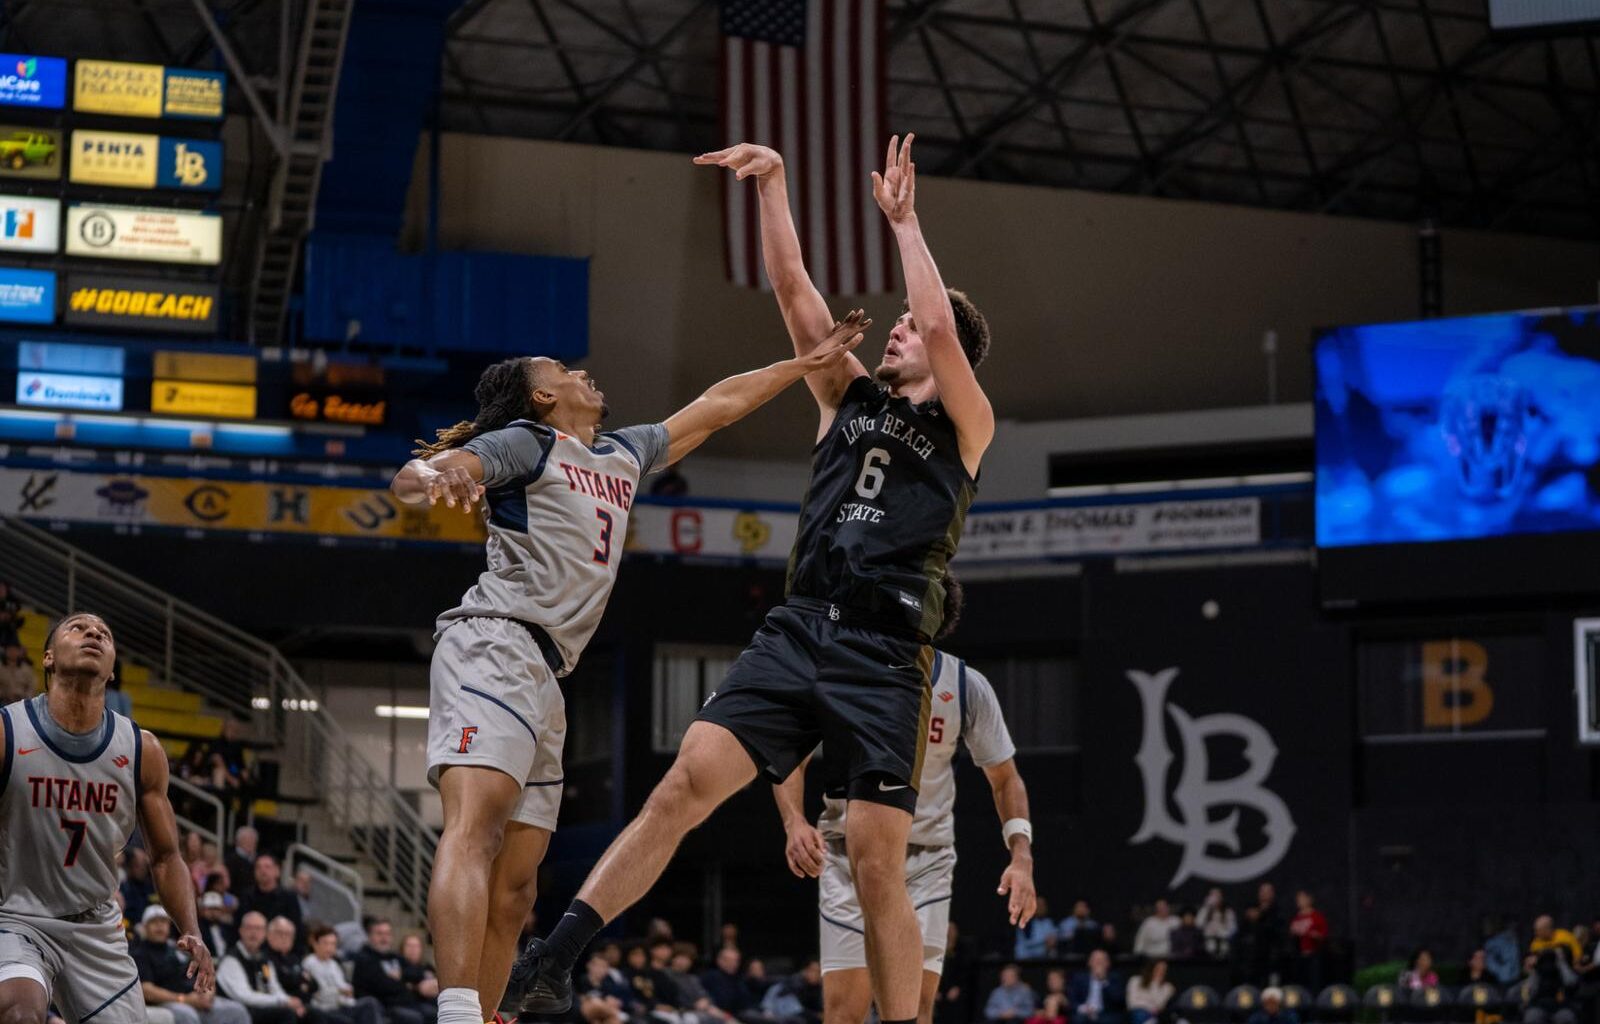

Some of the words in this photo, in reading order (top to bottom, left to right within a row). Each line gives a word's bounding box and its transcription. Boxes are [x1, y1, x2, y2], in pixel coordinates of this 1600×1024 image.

[82, 140, 145, 156] PENTA
[70, 288, 213, 320] #GOBEACH
[290, 393, 318, 418] Go
[324, 395, 385, 425] Beach
[841, 416, 876, 446] LONG
[880, 413, 936, 460] BEACH
[560, 462, 633, 513] TITANS
[854, 447, 891, 500] 6
[592, 506, 614, 566] 3
[836, 503, 886, 523] STATE
[1421, 639, 1494, 728] B
[457, 725, 478, 754] F
[29, 776, 118, 814] TITANS
[1125, 667, 1298, 890] LB
[61, 819, 87, 868] 7
